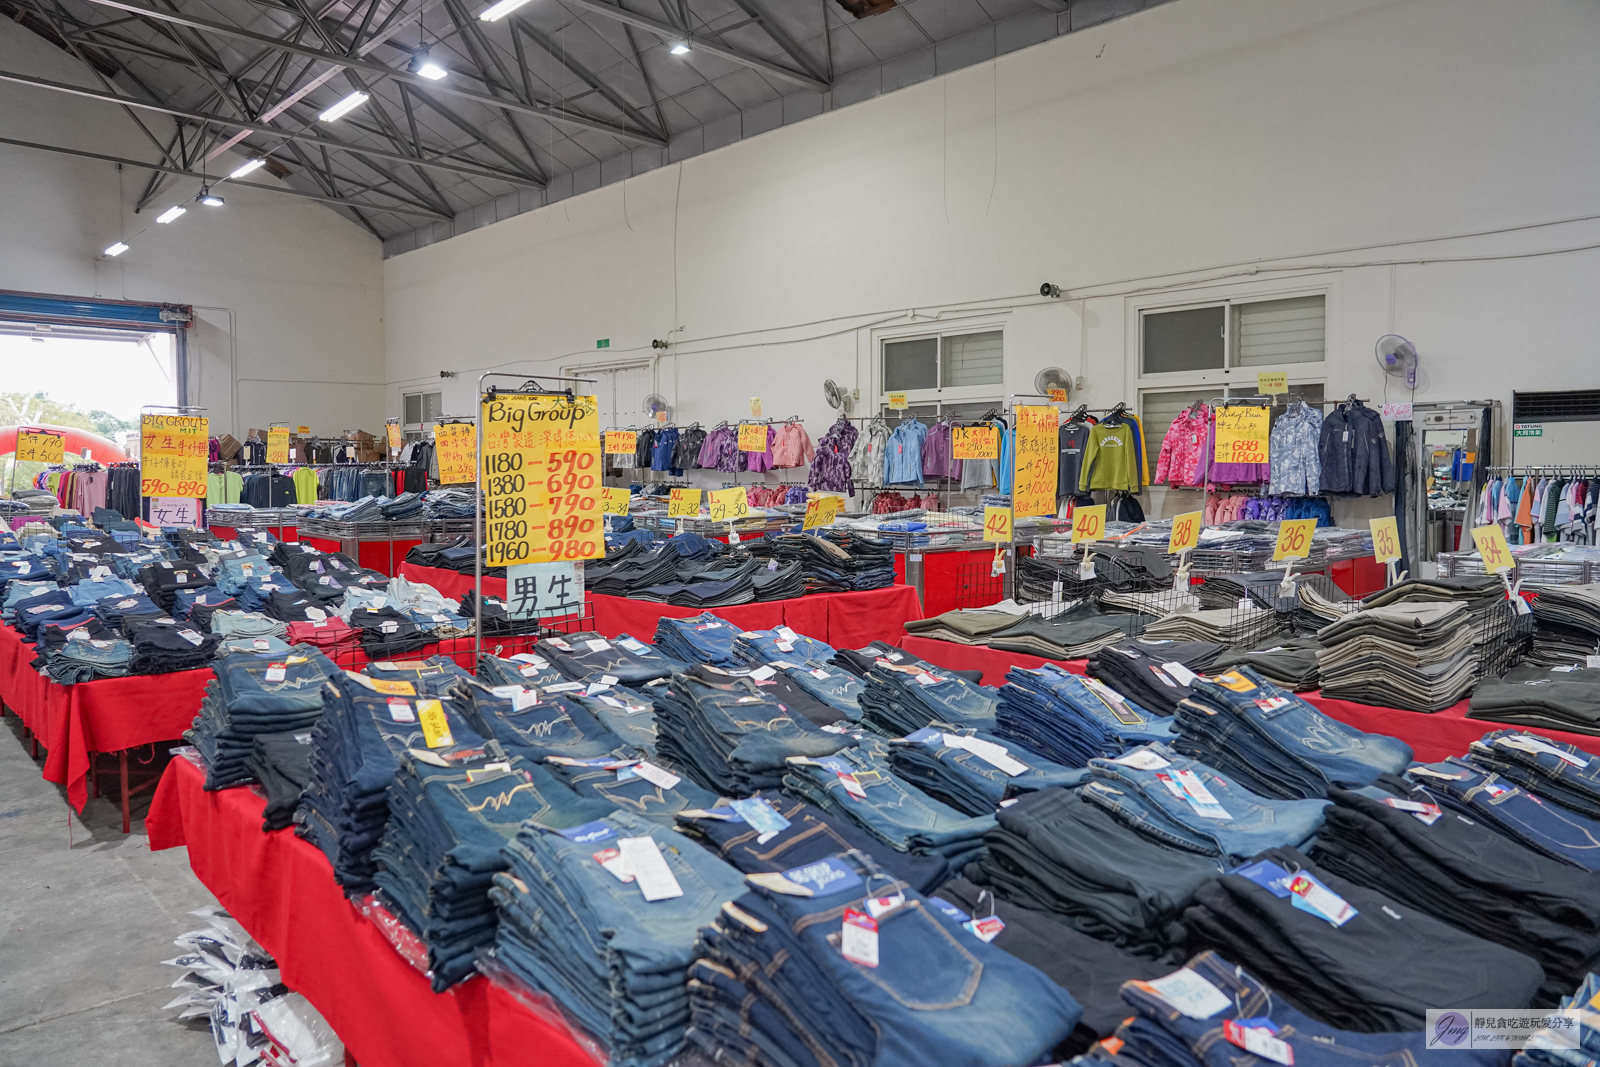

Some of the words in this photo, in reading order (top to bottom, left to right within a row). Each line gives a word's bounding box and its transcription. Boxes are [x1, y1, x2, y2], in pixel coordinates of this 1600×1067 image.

[142, 415, 164, 426] BIG
[165, 416, 209, 431] GROUP
[488, 402, 525, 433] Big
[527, 402, 585, 429] Group
[43, 437, 62, 448] 190
[1232, 440, 1259, 452] 688
[39, 449, 63, 462] 500
[486, 452, 522, 475] 1180
[546, 450, 594, 474] 590
[1034, 455, 1055, 479] 590
[1231, 451, 1264, 463] 1800
[457, 463, 473, 473] 390
[488, 474, 525, 497] 1380
[546, 472, 594, 495] 690
[670, 489, 683, 501] XL
[1030, 480, 1054, 497] 1000
[489, 497, 526, 520] 1580
[548, 494, 596, 516] 790
[710, 491, 720, 505] L
[807, 500, 820, 514] M
[1041, 497, 1055, 515] 30
[153, 507, 193, 525] 女生
[986, 513, 1008, 536] 42
[1076, 514, 1099, 538] 40
[489, 520, 528, 542] 1780
[547, 514, 595, 540] 890
[1173, 519, 1193, 547] 38
[1281, 524, 1306, 553] 36
[489, 541, 529, 563] 1960
[549, 540, 596, 562] 980
[1377, 526, 1394, 557] 35
[1480, 535, 1502, 564] 34
[511, 574, 580, 617] 男生
